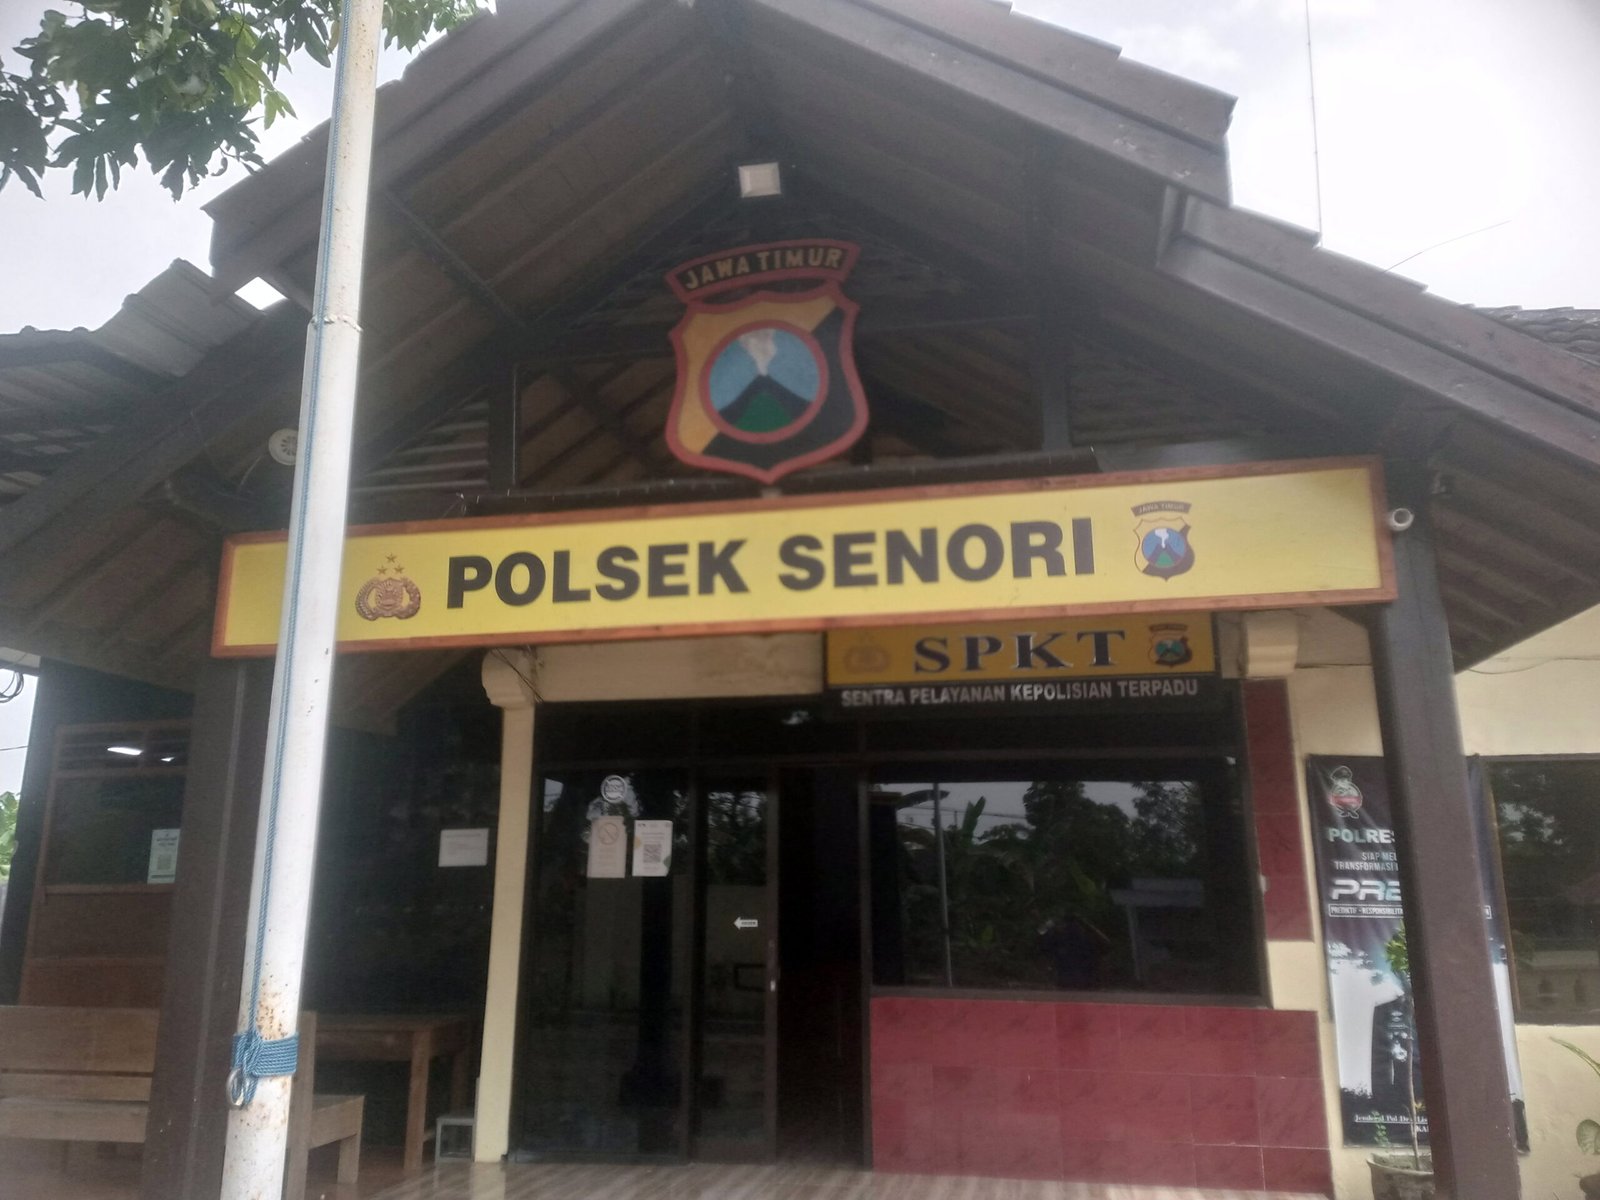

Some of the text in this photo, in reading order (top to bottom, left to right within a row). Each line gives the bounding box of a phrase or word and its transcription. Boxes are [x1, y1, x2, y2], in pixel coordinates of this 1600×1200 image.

[686, 247, 843, 290] JAWA TIMUR
[447, 517, 1096, 609] POLSEK SENORI
[913, 629, 1126, 674] SPKT
[841, 678, 1198, 707] SENTRA PELAYANAN KEPOLISIAN TERPADU
[1334, 861, 1394, 871] TRANSFORMASI
[1361, 852, 1380, 861] SIAP
